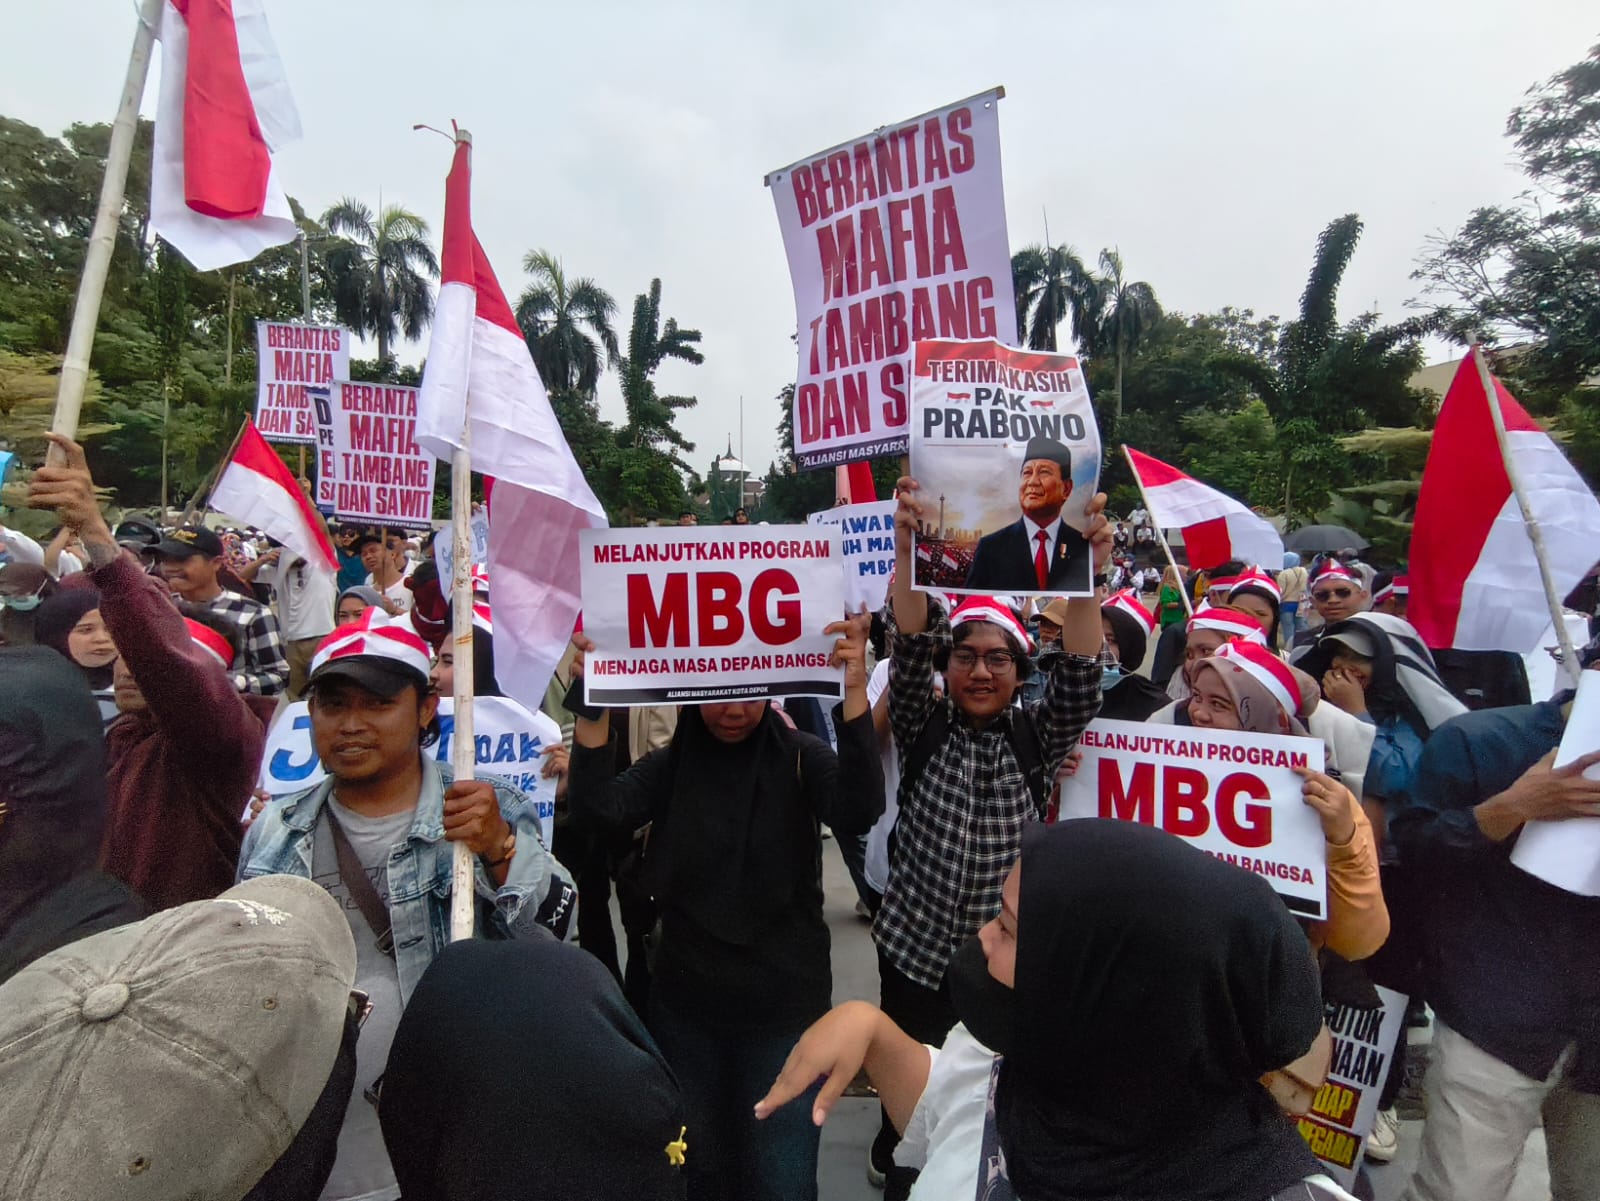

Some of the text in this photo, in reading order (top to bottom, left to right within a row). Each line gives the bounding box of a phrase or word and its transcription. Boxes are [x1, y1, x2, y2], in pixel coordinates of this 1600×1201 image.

[791, 107, 975, 228] BERANTAS
[816, 185, 968, 304] MAFIA
[267, 324, 341, 351] BERANTAS
[809, 276, 998, 375] TAMBANG
[274, 350, 333, 384] MAFIA
[341, 383, 417, 417] BERANTA
[798, 360, 911, 444] DAN S
[974, 387, 1028, 413] PAK
[258, 408, 292, 434] DAN
[350, 414, 420, 456] MAFIA
[923, 407, 1086, 442] PRABOWO
[321, 449, 336, 479] E
[803, 438, 909, 467] ALIANSI MASYARA
[342, 453, 429, 488] TAMBANG
[337, 484, 431, 519] DAN SAWIT
[594, 539, 830, 563] MELANJUTKAN PROGRAM
[627, 568, 802, 648] MBG
[593, 658, 671, 675] MENJAGA
[674, 657, 717, 673] MASA
[721, 655, 772, 672] DEPAN
[1207, 744, 1308, 769] PROGRAM
[1097, 757, 1273, 848] MBG
[1241, 855, 1314, 885] BANGSA
